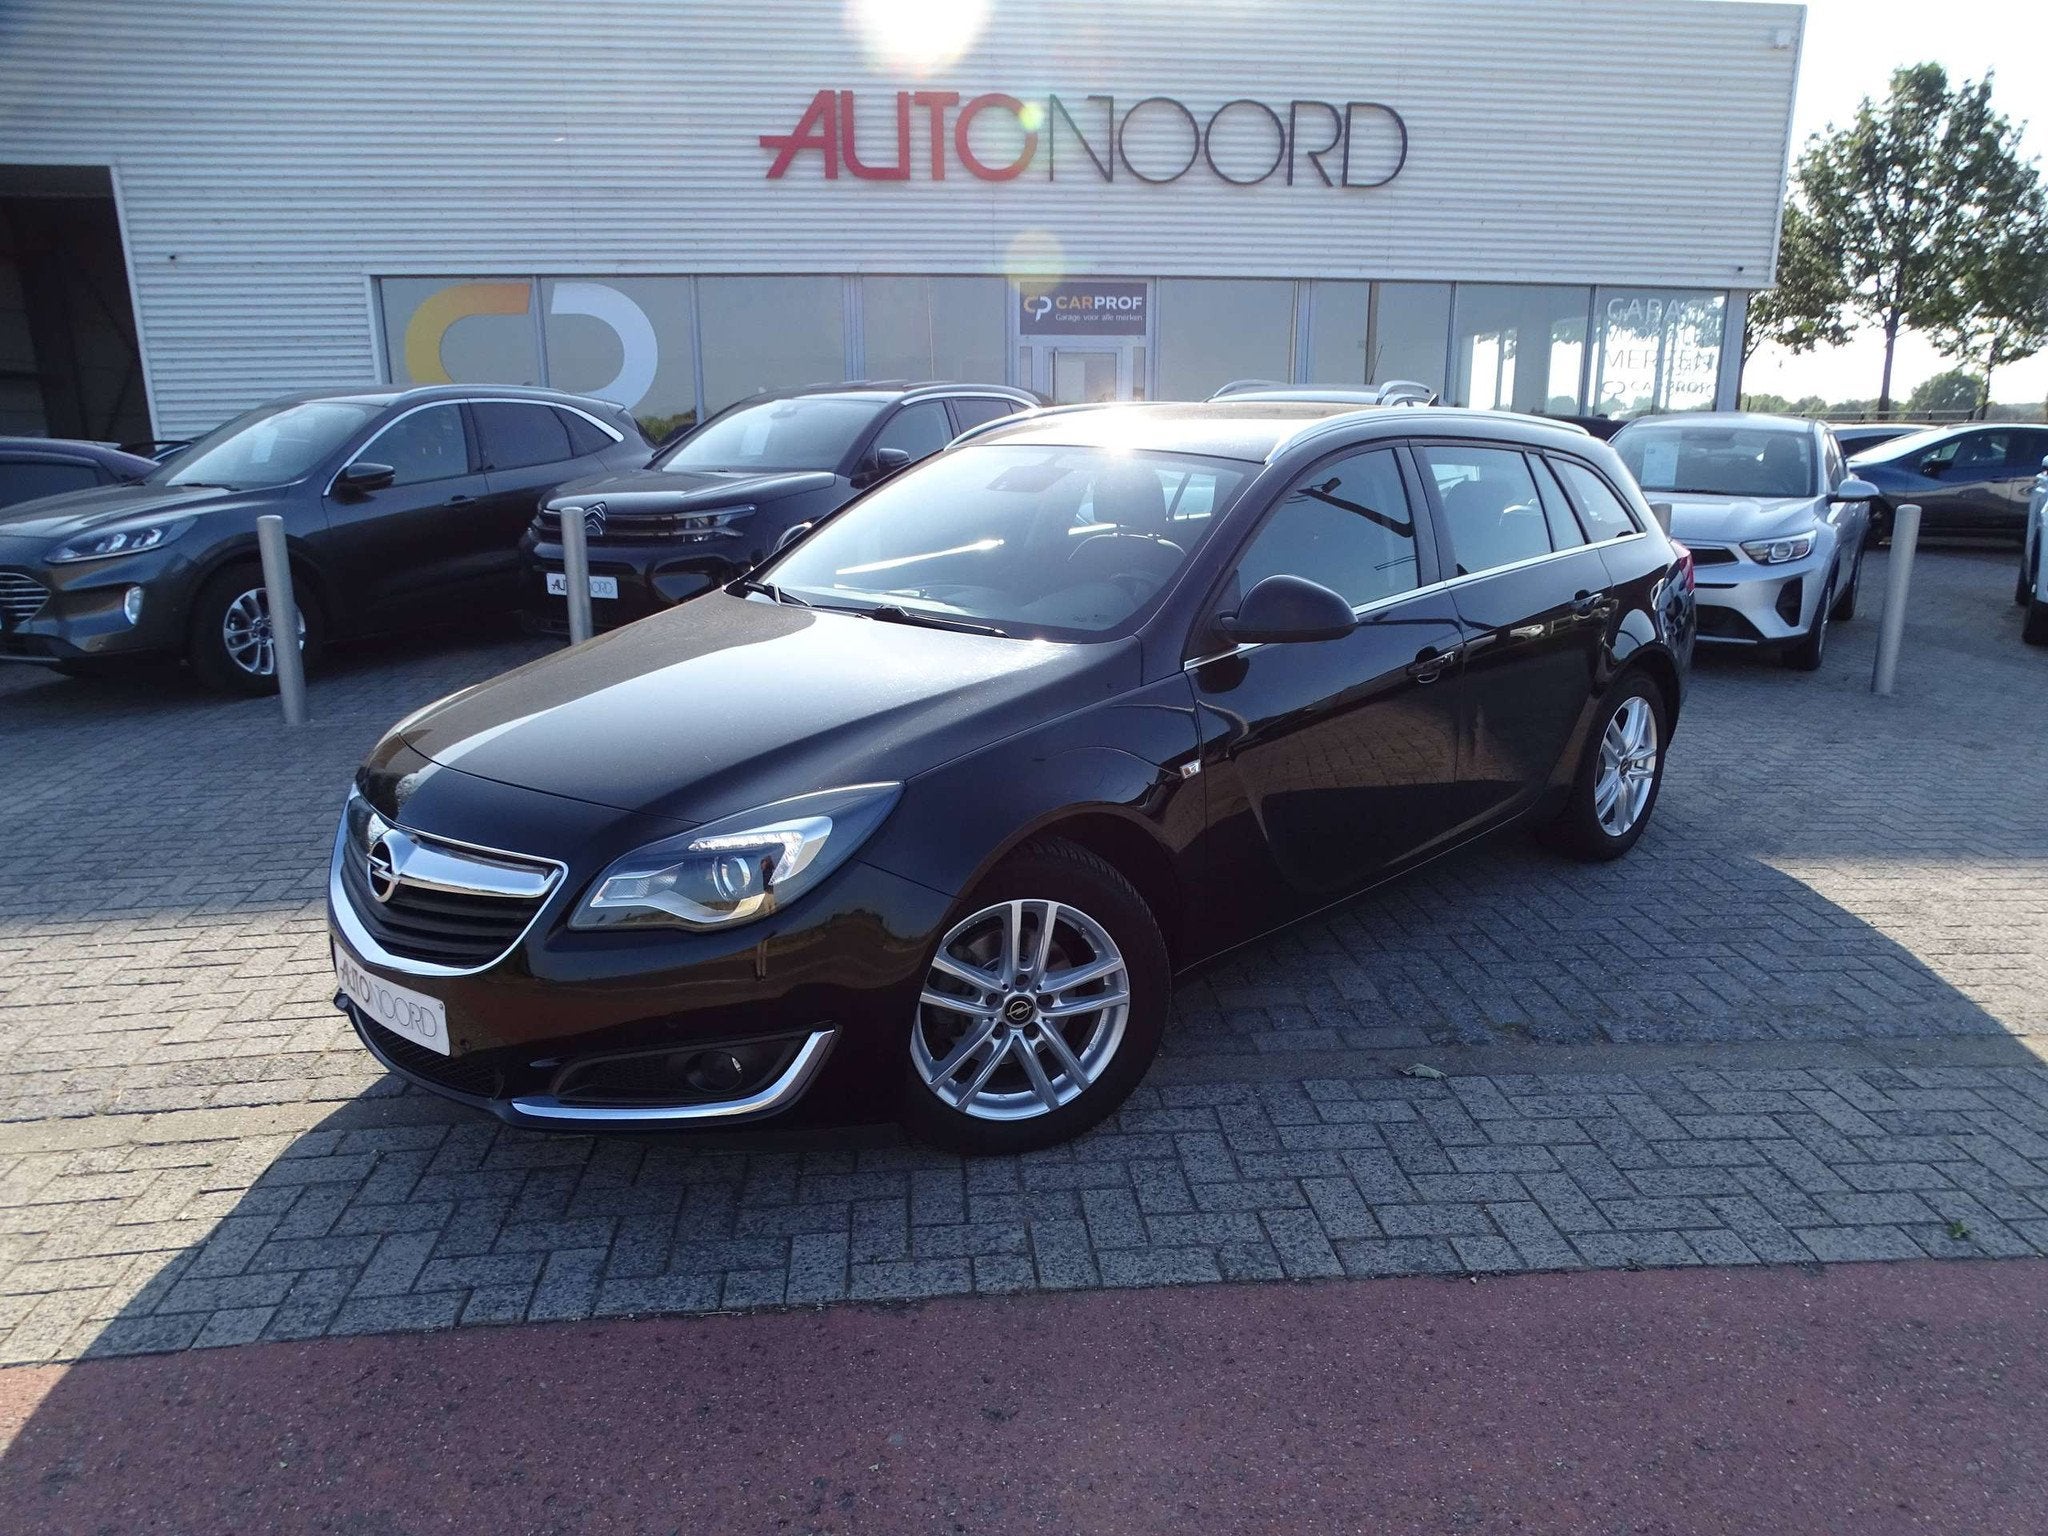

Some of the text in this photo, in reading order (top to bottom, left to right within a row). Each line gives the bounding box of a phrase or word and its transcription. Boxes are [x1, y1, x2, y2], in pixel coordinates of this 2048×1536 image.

[759, 90, 1409, 188] AUTONOORD
[1055, 295, 1143, 310] CARPROF
[1055, 313, 1081, 322] Garage
[1115, 313, 1143, 321] merken
